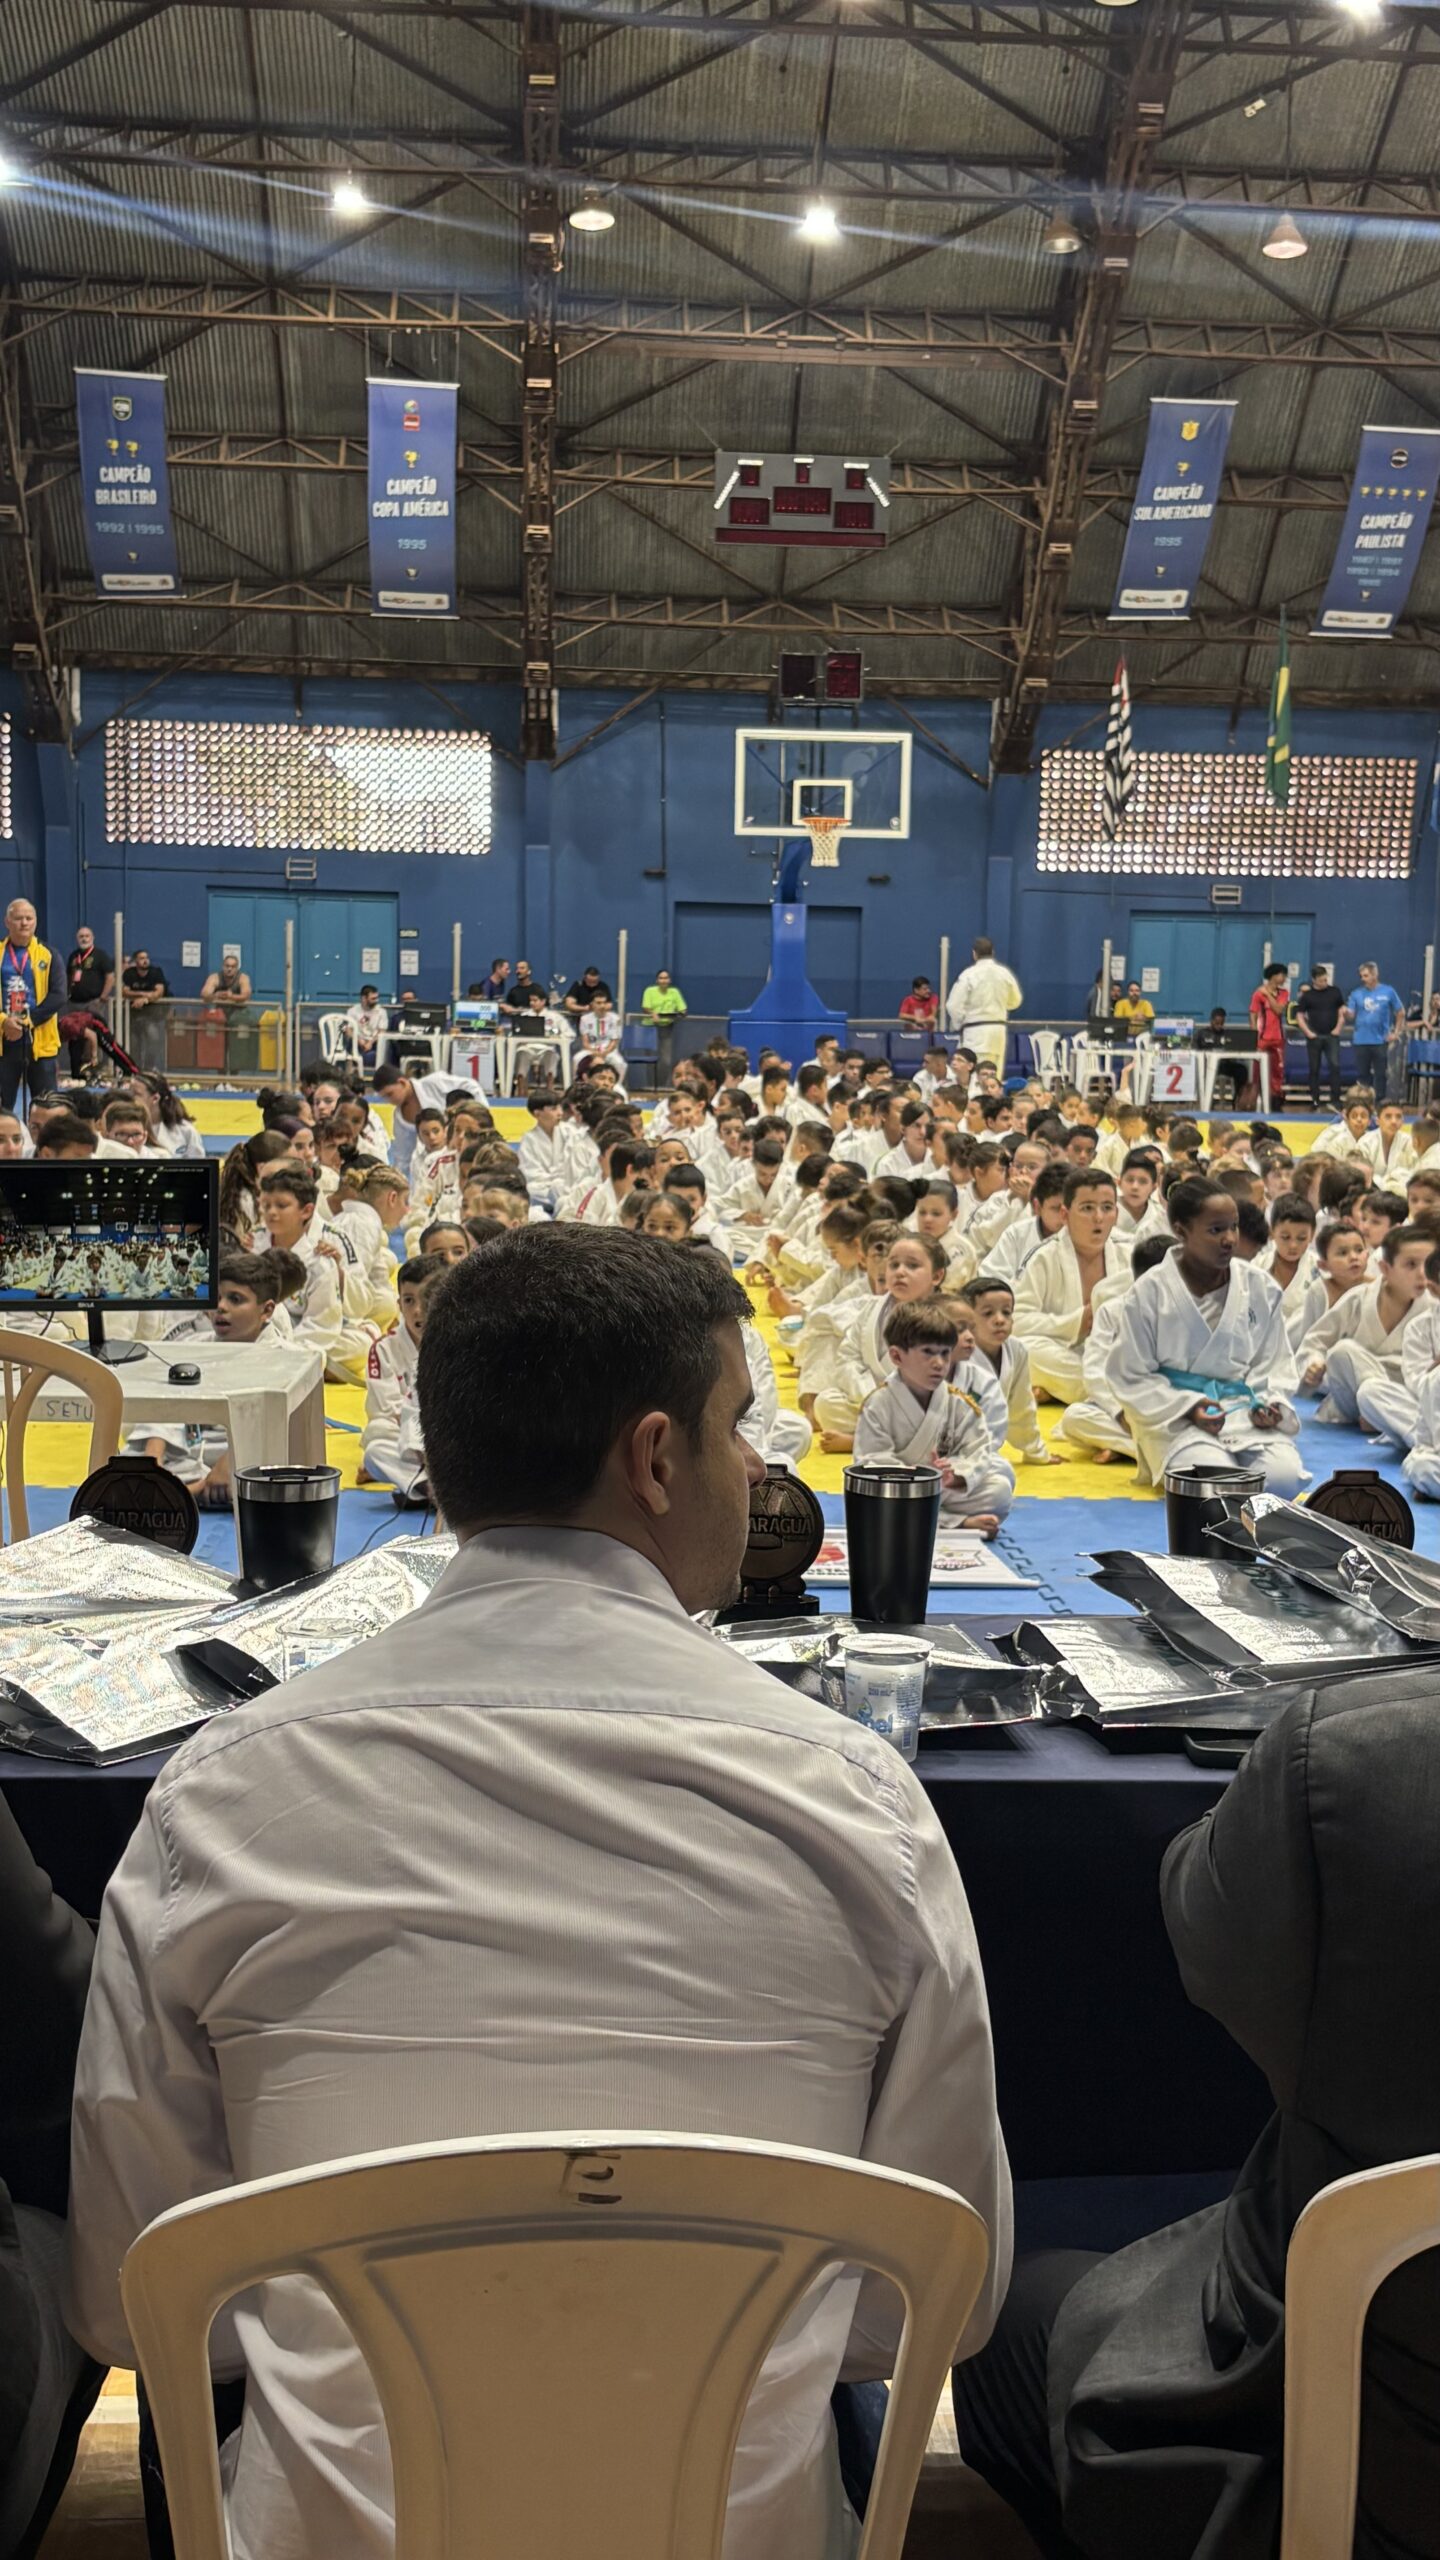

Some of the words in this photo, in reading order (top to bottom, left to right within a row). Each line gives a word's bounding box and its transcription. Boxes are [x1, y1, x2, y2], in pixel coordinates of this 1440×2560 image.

[100, 464, 151, 483] CAMPEÃO
[386, 476, 437, 496] CAMPEÃO
[1153, 483, 1204, 501] CAMPEÃO
[95, 489, 157, 505] BRASILEIRO
[372, 501, 400, 518] COPA
[402, 498, 449, 517] AMÉRICA
[1133, 504, 1213, 521] SULAMERICANO
[96, 522, 125, 534] 1992
[134, 523, 165, 535] 1995
[1360, 511, 1414, 530] CAMPEÃO
[397, 538, 427, 550] 1995
[1153, 536, 1183, 547] 1995
[1354, 533, 1406, 549] PAULISTA
[466, 1055, 480, 1081] 1
[1166, 1064, 1184, 1095] 2
